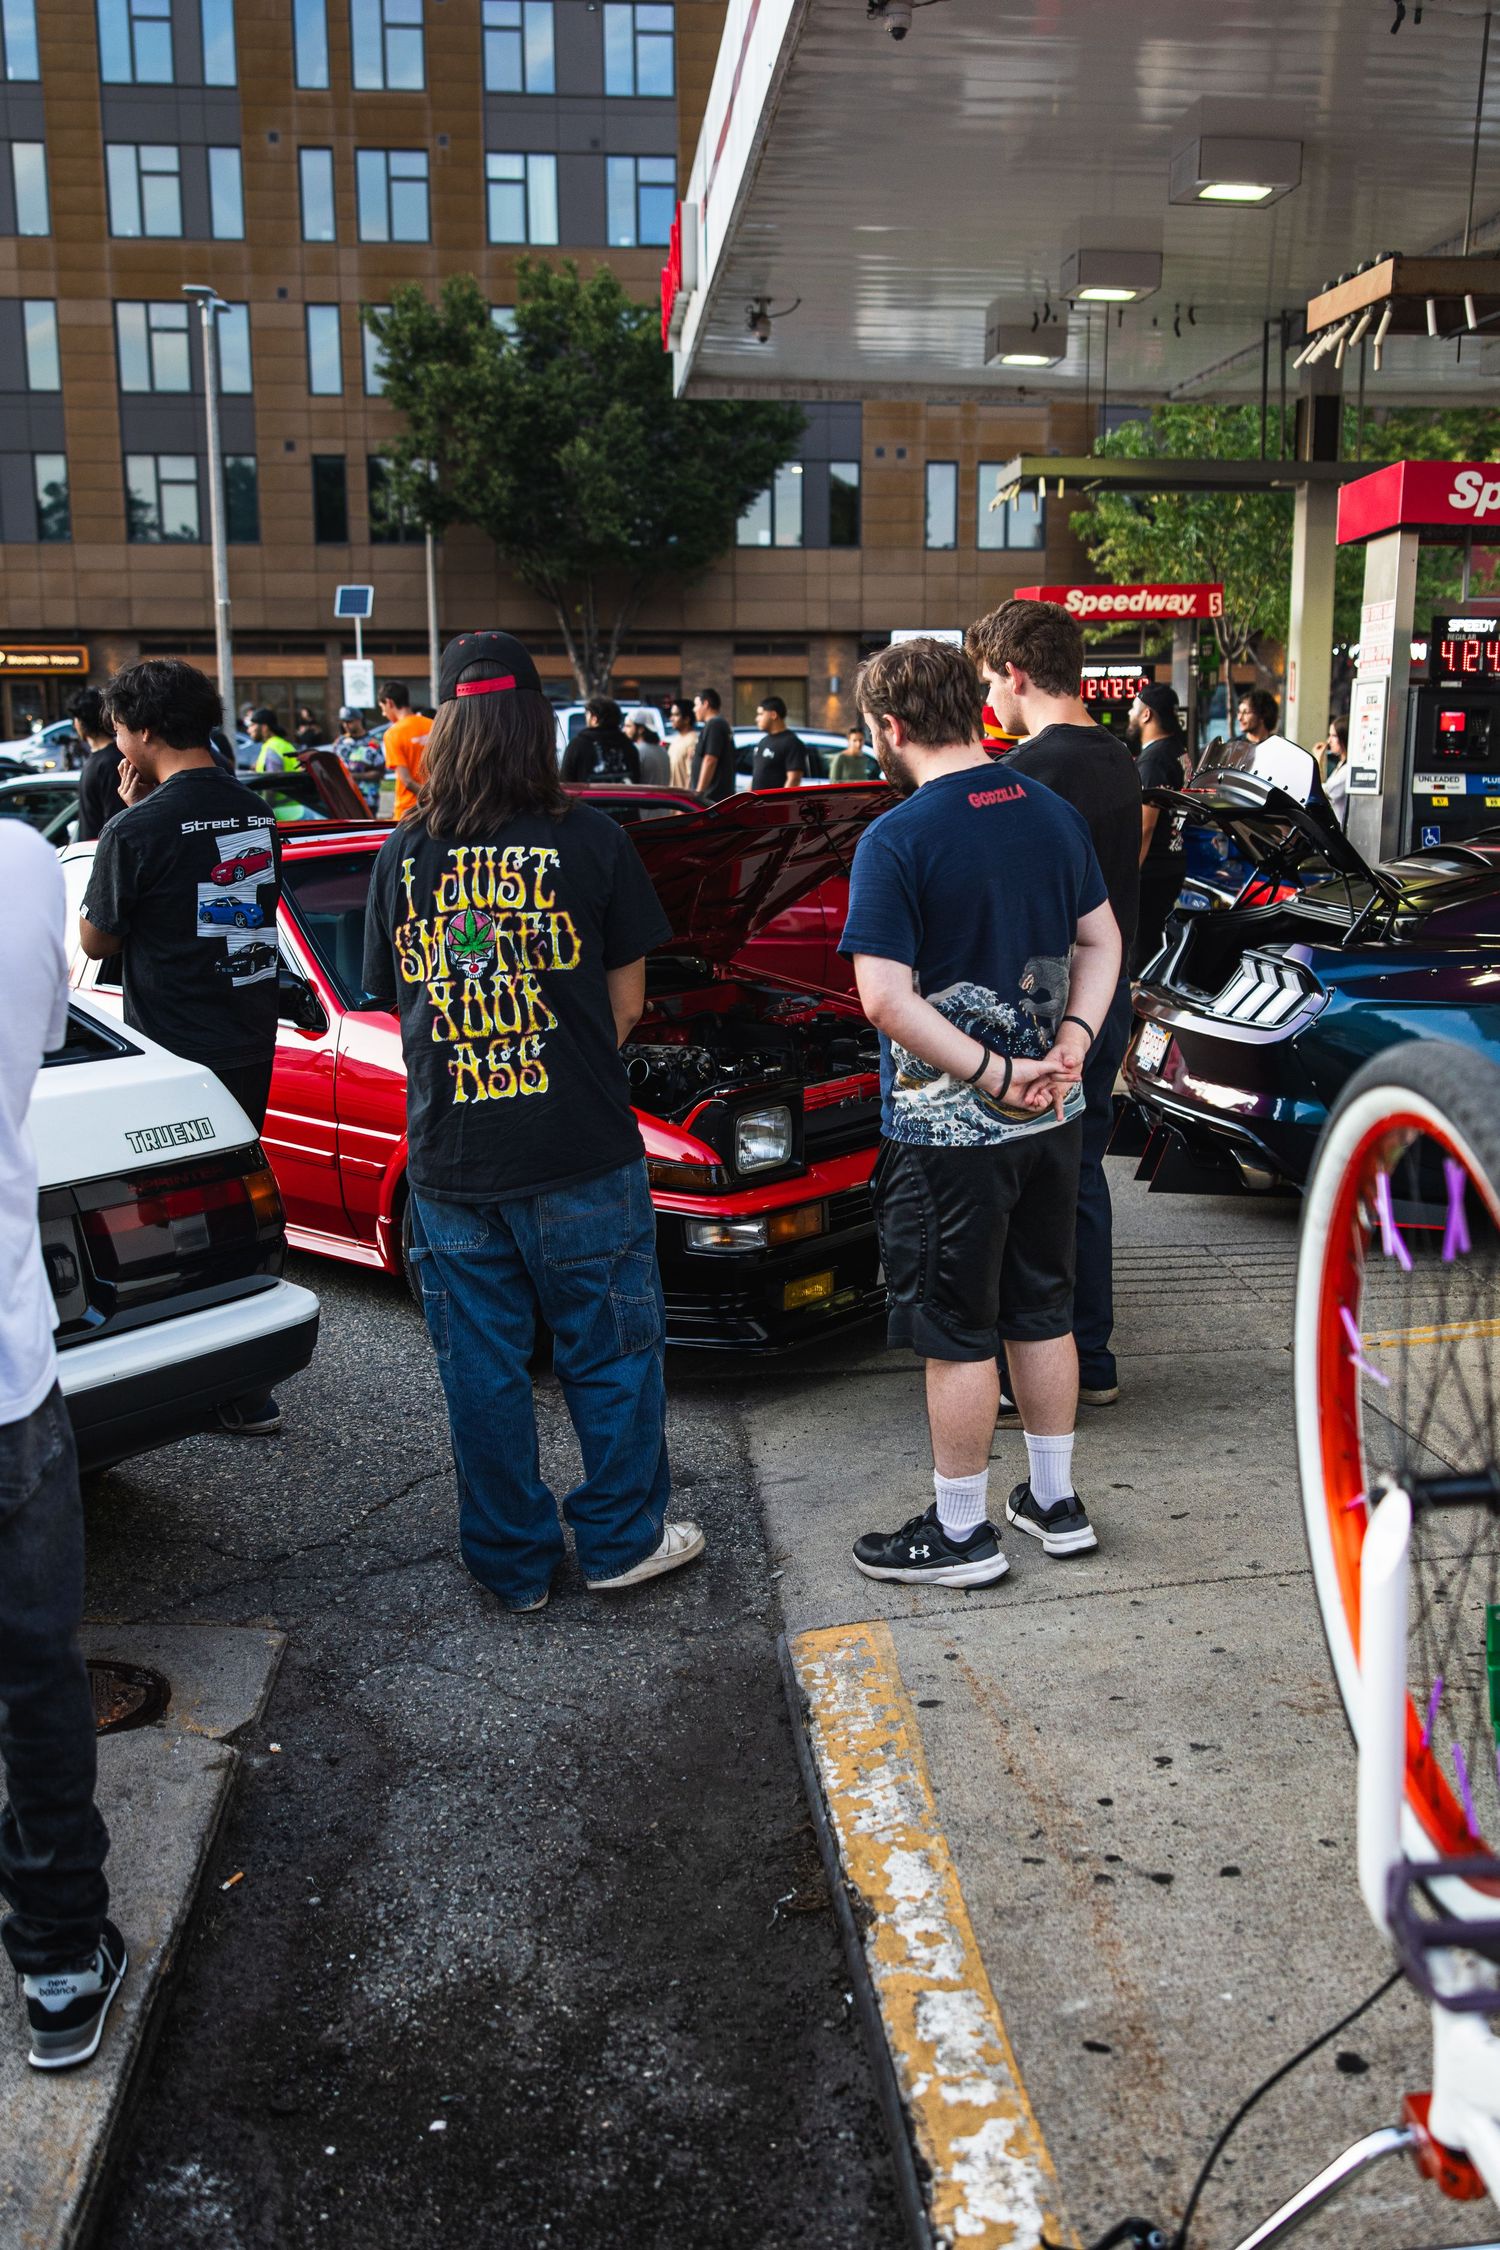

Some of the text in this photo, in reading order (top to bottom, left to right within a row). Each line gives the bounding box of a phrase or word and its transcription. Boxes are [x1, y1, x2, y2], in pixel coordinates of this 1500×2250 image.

[1064, 590, 1197, 616] Speedway
[1210, 593, 1221, 616] 5
[1447, 633, 1477, 641] REGULAR
[1448, 619, 1497, 632] SPEEDY
[1418, 775, 1460, 783] UNLEADED
[968, 784, 1027, 808] GODZILLA
[181, 817, 239, 834] Street
[400, 846, 561, 921] I JUST
[427, 972, 558, 1043] YOUR
[448, 1034, 549, 1105] ASS
[125, 1117, 216, 1154] TRUENO
[39, 1985, 77, 1996] balance
[48, 1978, 67, 1986] new
